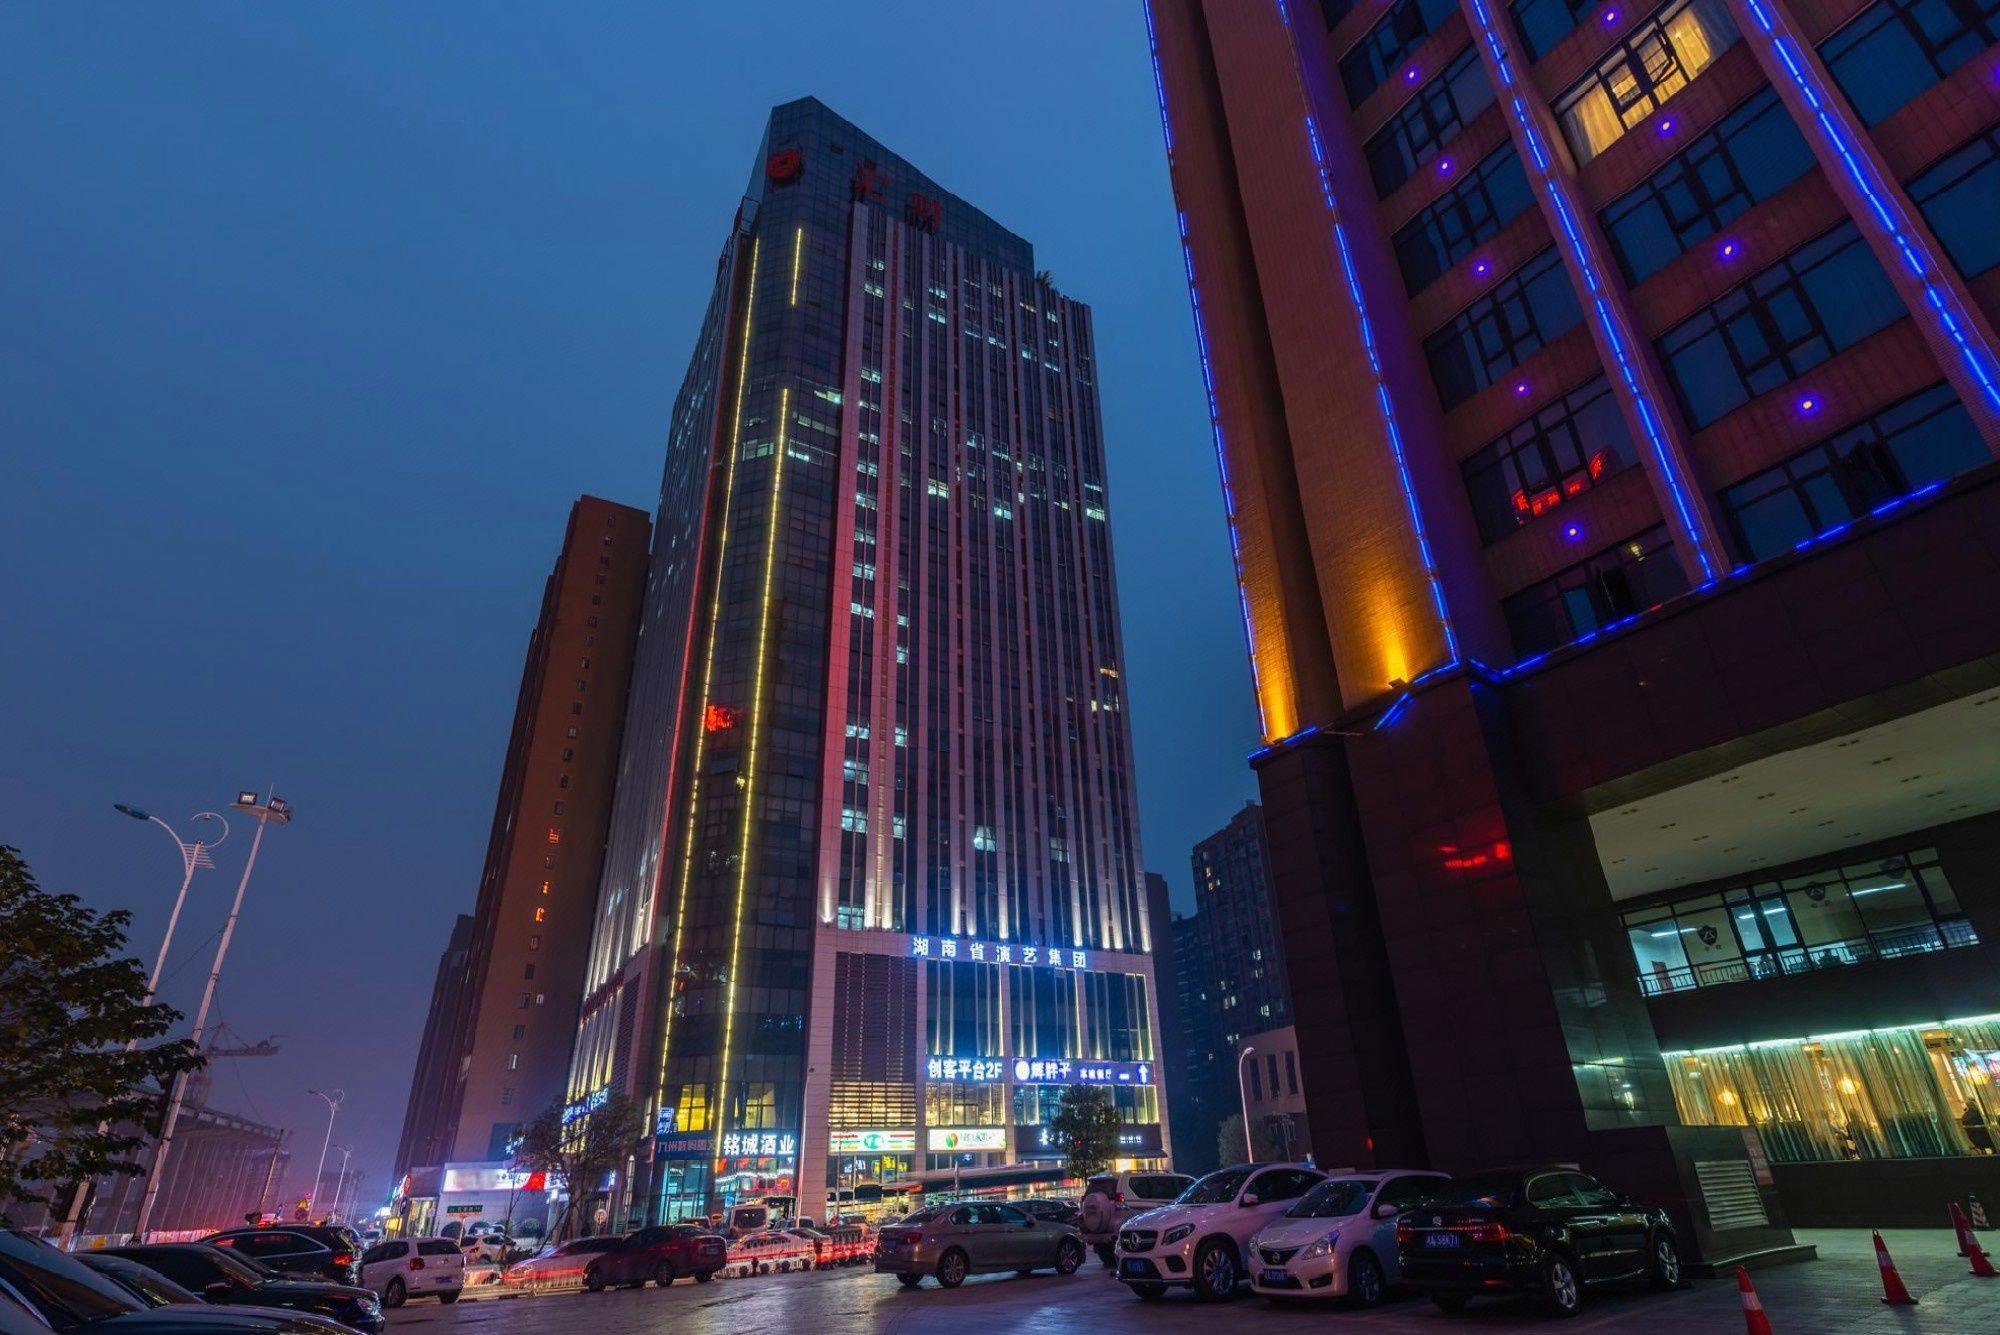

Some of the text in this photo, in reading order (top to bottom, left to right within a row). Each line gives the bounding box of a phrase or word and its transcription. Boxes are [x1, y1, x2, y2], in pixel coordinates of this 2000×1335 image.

[913, 937, 1086, 967] 湖南省演艺集团
[928, 1059, 1003, 1081] 创客平台2F
[723, 1133, 795, 1156] 铭城酒业
